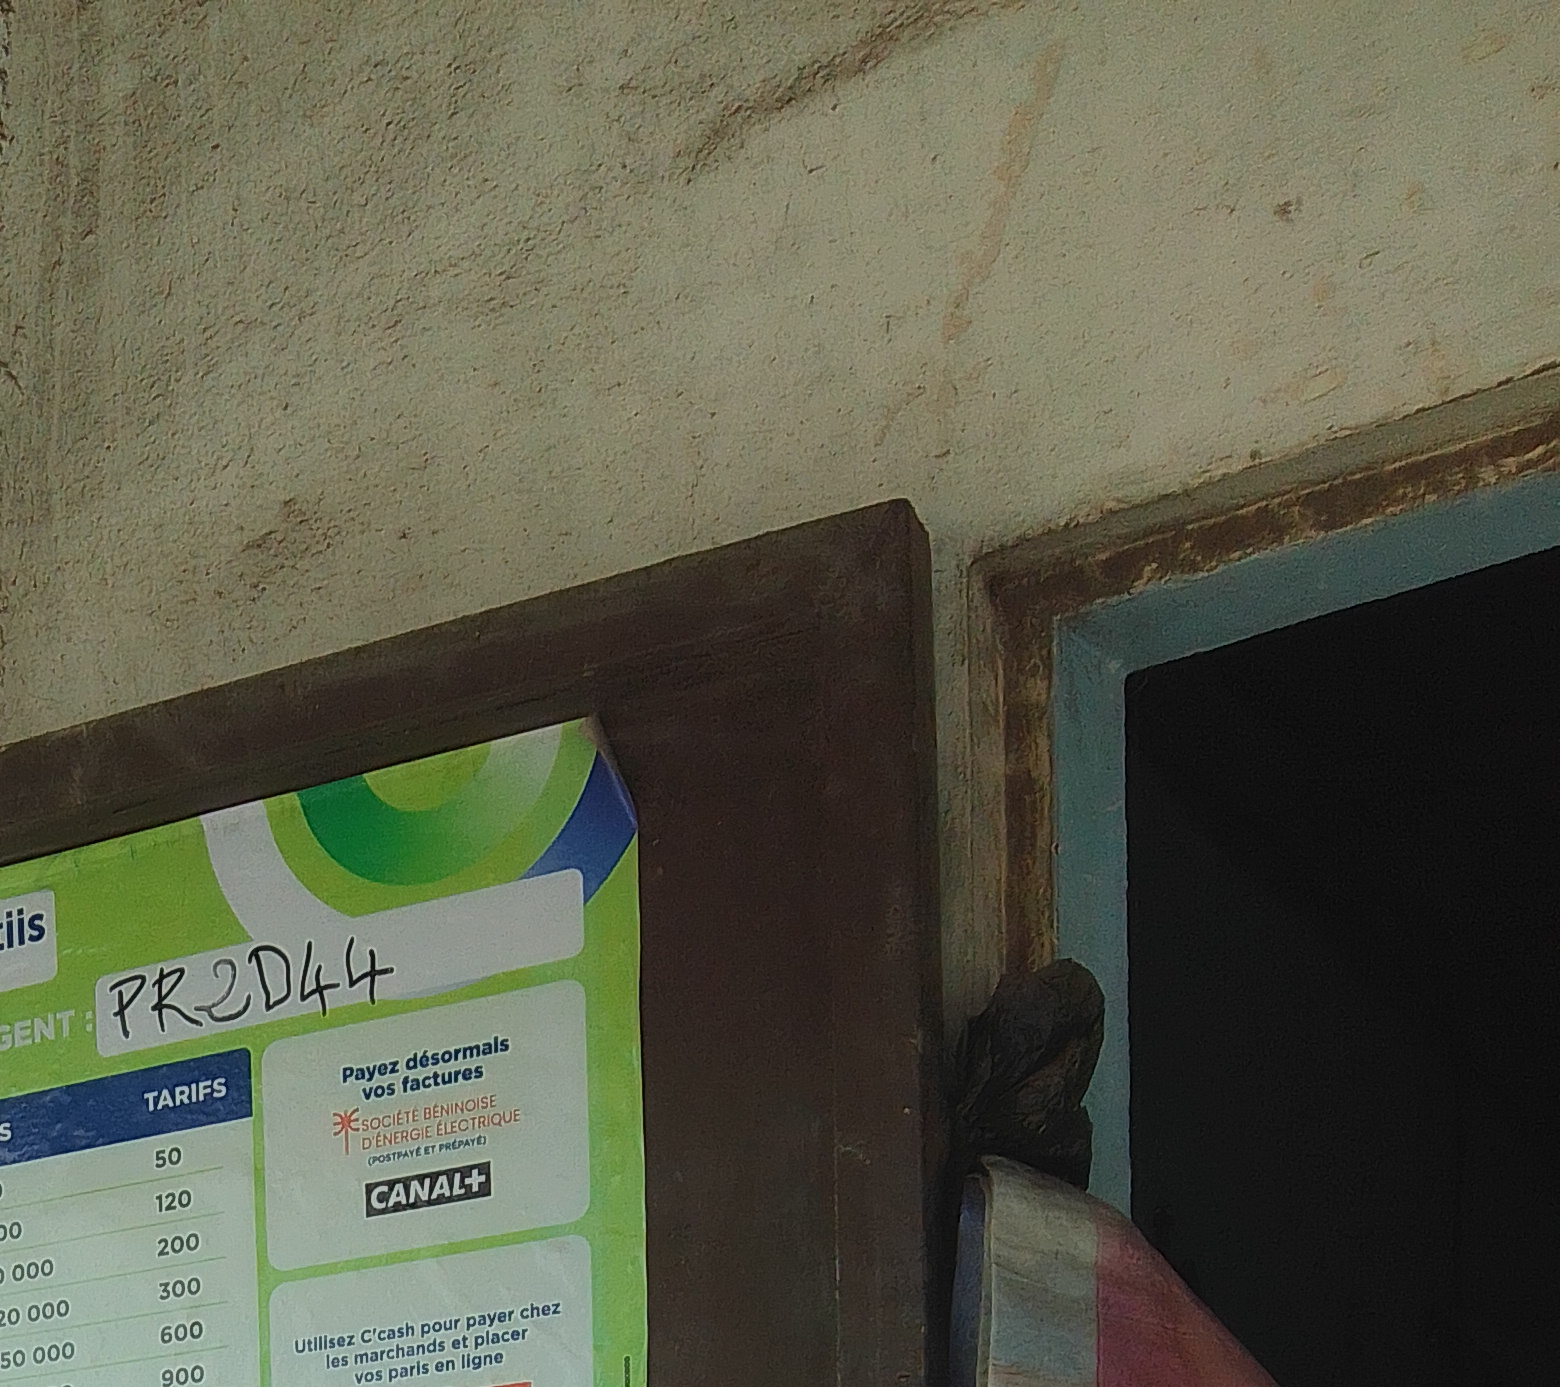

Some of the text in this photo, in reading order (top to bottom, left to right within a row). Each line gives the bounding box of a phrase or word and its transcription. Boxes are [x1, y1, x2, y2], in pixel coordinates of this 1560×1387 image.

[342, 1035, 510, 1084] Payez désormais
[143, 1077, 227, 1111] TARIFS
[362, 1063, 484, 1100] vos factures
[361, 1094, 498, 1132] SOCIÉTÉ BÉNINOISE
[362, 1108, 521, 1151] D'ÉNERGIE ÉLECTRIQUE
[154, 1146, 182, 1169] 50
[424, 1146, 436, 1156] ET
[155, 1189, 192, 1213] 120
[369, 1167, 487, 1210] CANAL+
[156, 1232, 200, 1258] 200
[158, 1277, 201, 1301] 300
[160, 1320, 203, 1344] 600
[294, 1301, 561, 1355] Utilisez C'cash pour payer chez
[326, 1327, 529, 1370] les marchands et placer
[161, 1365, 205, 1387] 900
[355, 1350, 504, 1385] vos paris en ligne
